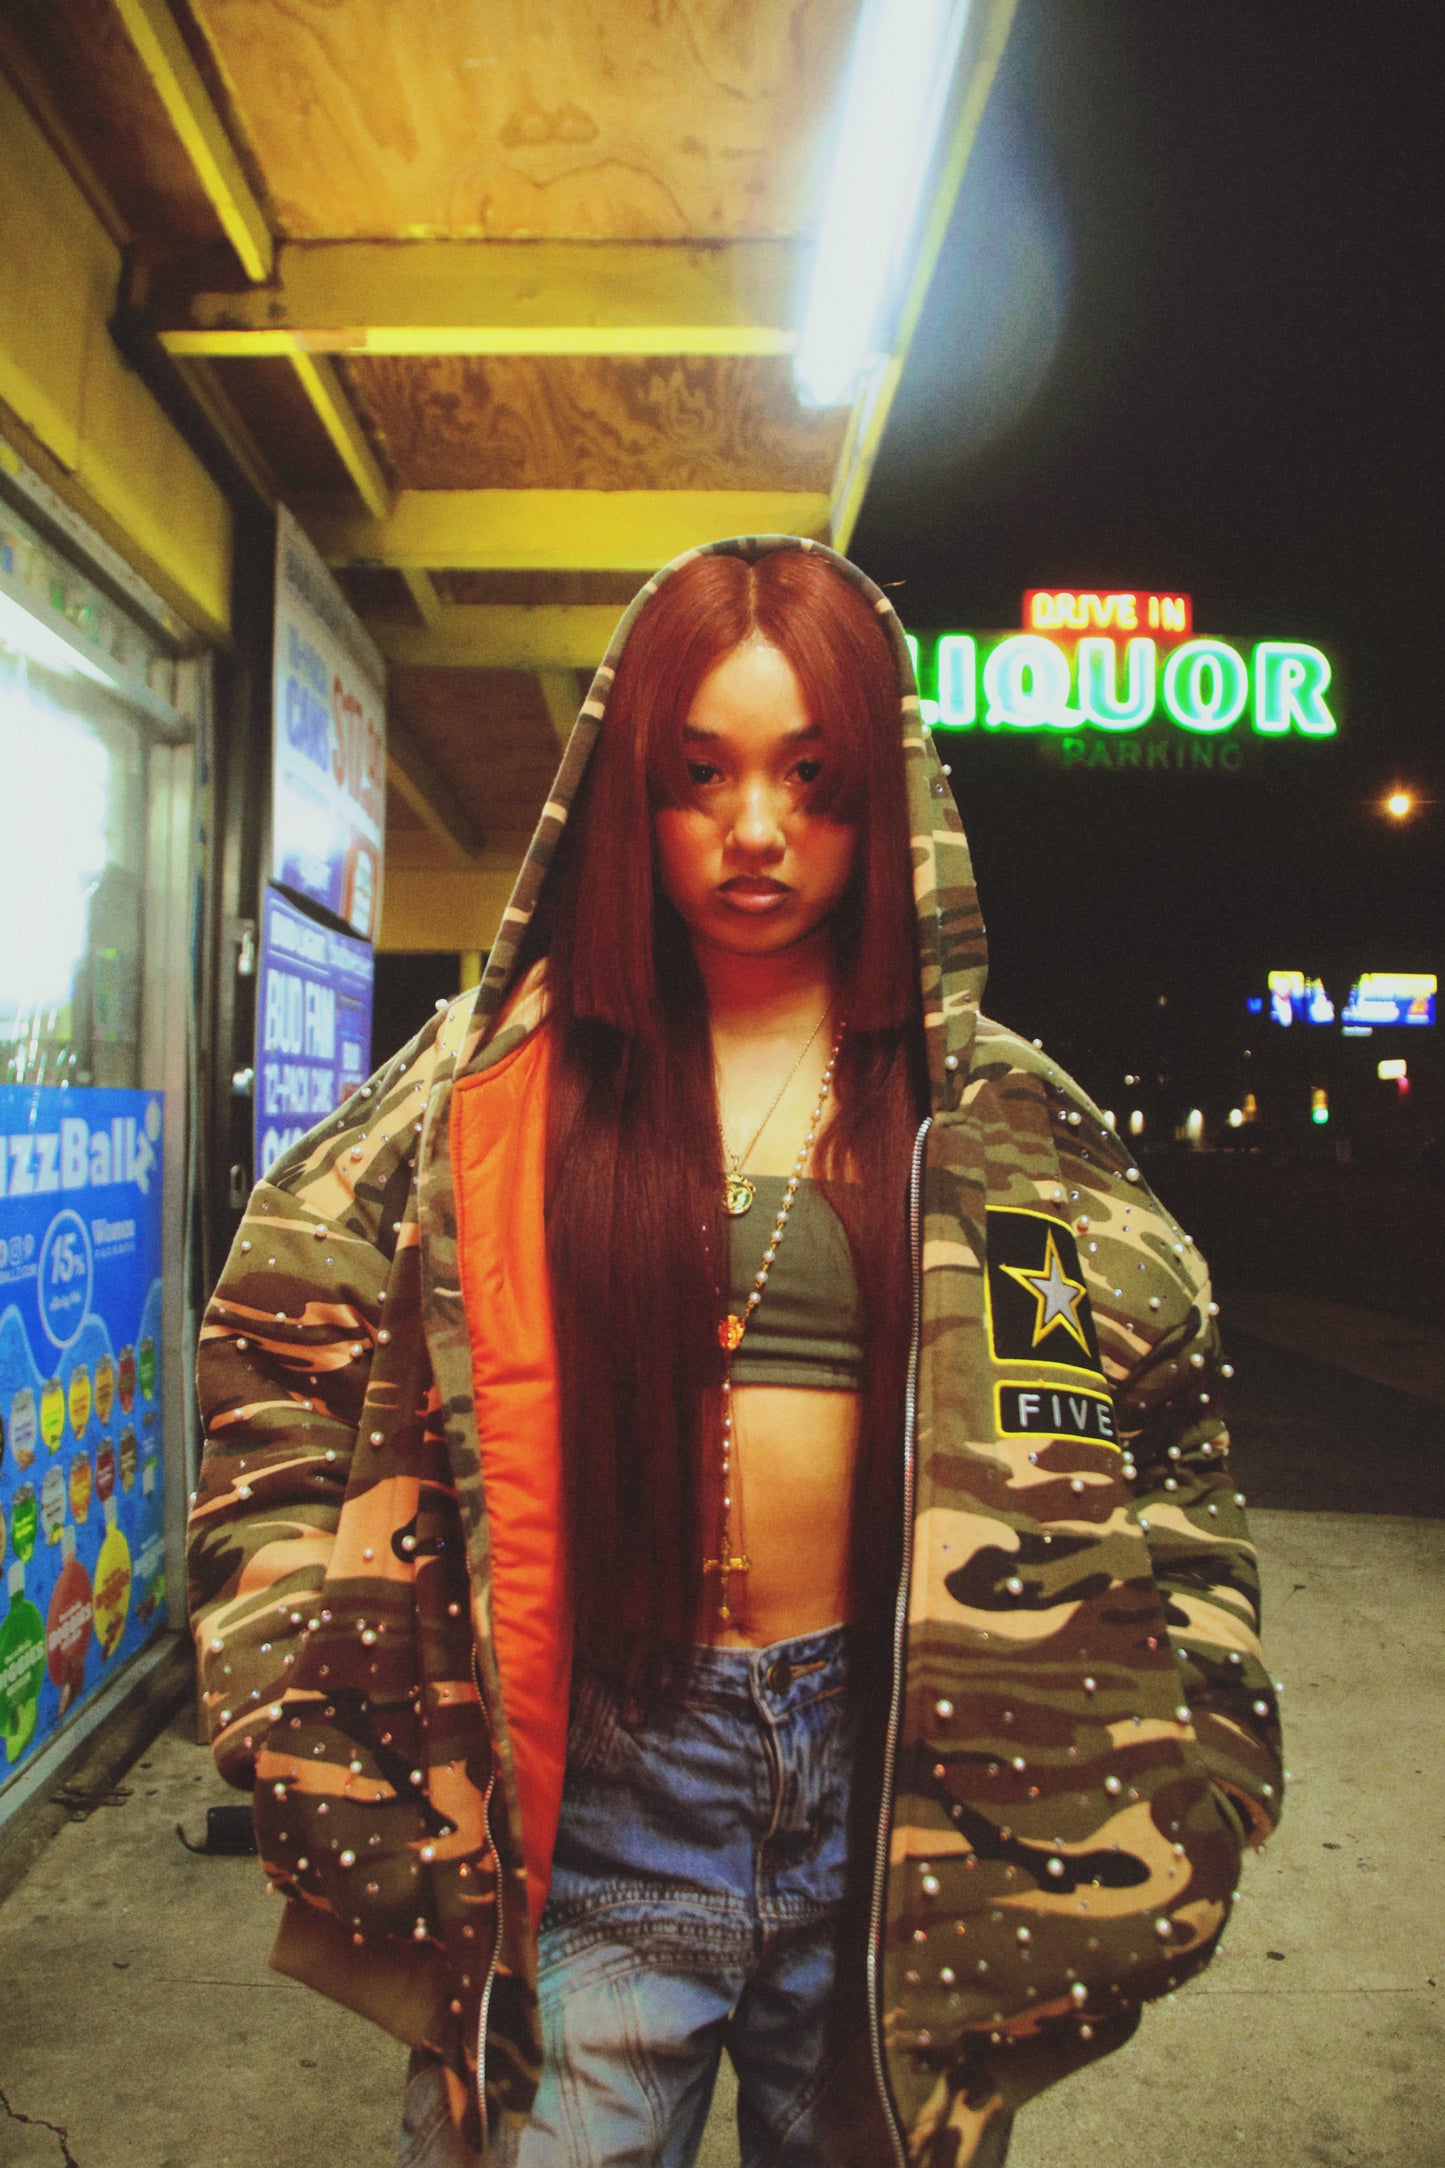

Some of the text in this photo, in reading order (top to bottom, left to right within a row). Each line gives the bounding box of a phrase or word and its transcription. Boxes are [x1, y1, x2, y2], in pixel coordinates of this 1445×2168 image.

[1032, 592, 1186, 632] DRIVE IN
[1061, 737, 1242, 770] PARKING
[1019, 1394, 1113, 1436] FIVE
